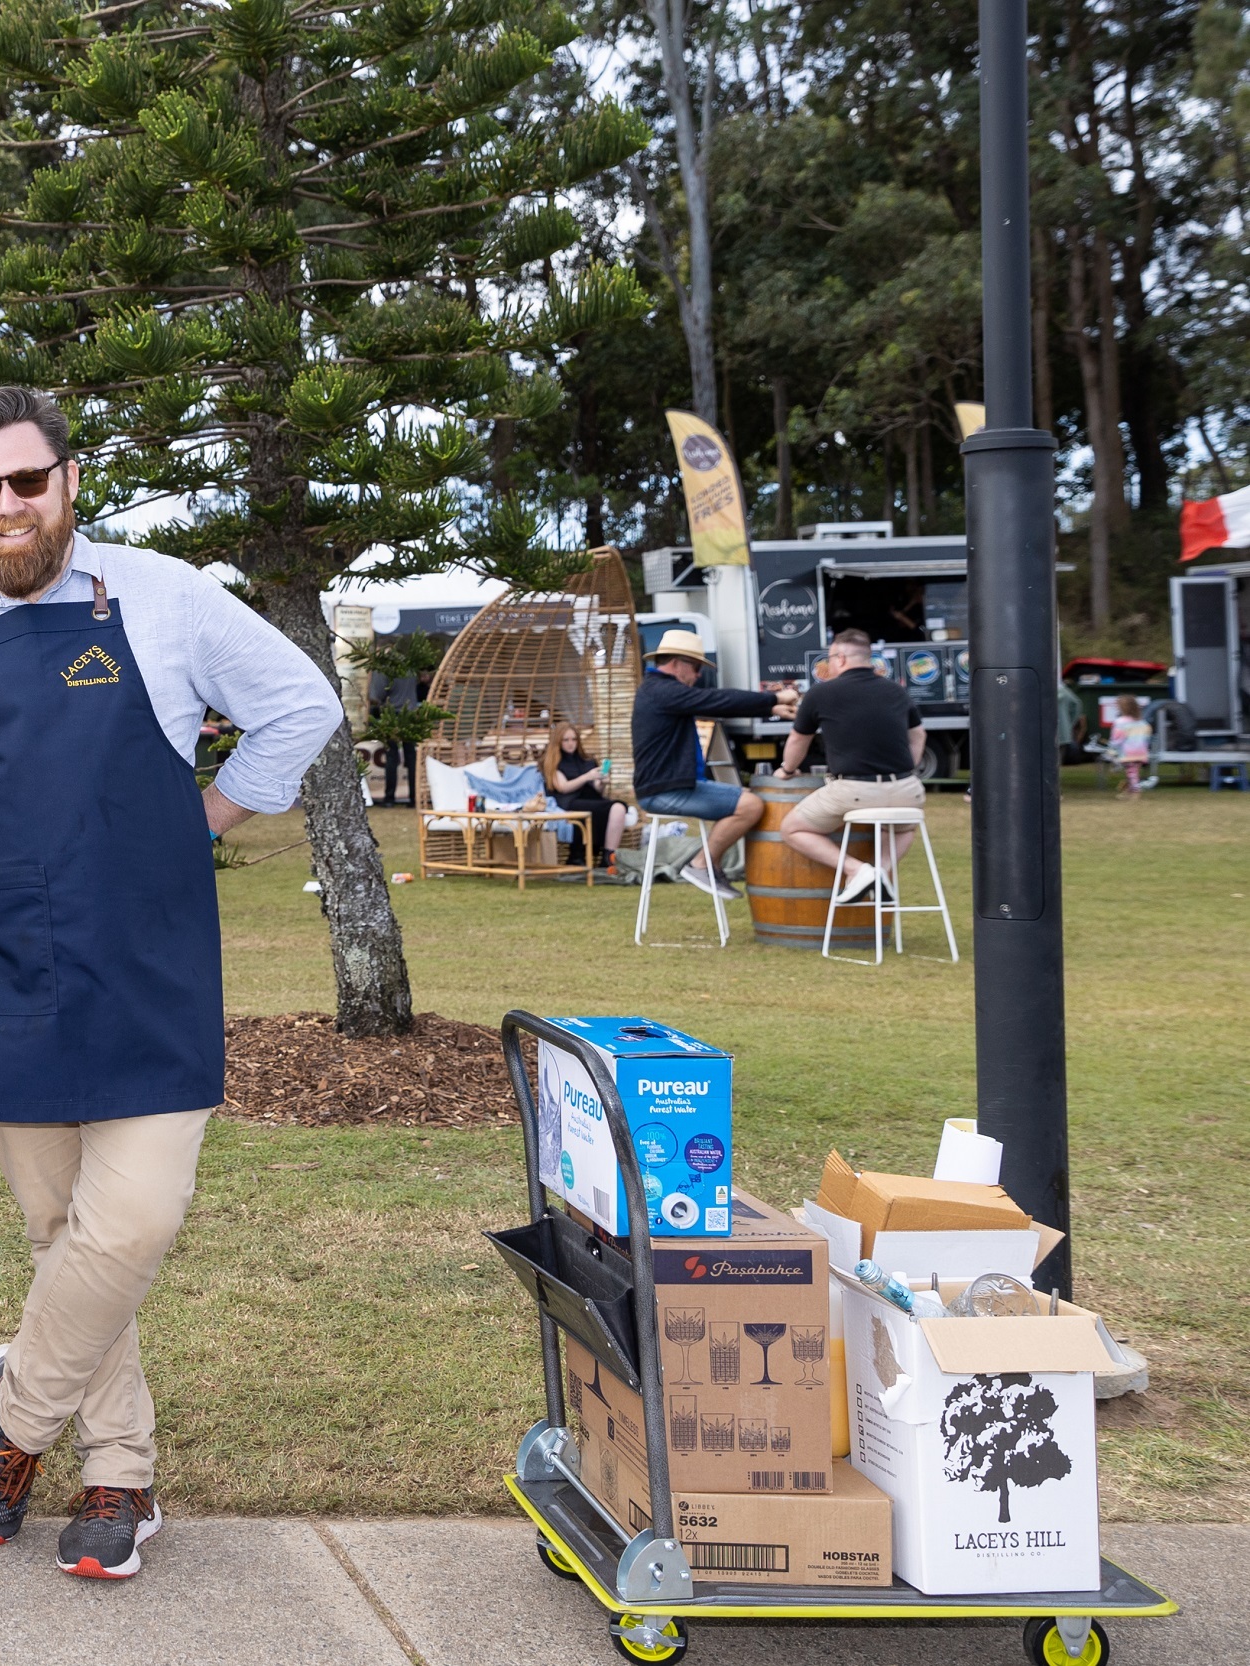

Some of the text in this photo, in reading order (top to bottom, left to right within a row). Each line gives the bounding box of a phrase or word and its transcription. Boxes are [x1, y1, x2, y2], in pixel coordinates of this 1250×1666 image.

[693, 493, 734, 524] FRIES
[67, 677, 108, 687] DISTILLING
[638, 1079, 708, 1096] Pureau
[563, 1080, 603, 1121] Pureau
[649, 1105, 697, 1114] Purest Water
[679, 1515, 718, 1527] 5632
[679, 1528, 698, 1540] 12x
[954, 1530, 1066, 1550] LACEYS HILL
[823, 1551, 880, 1562] HOBSTAR
